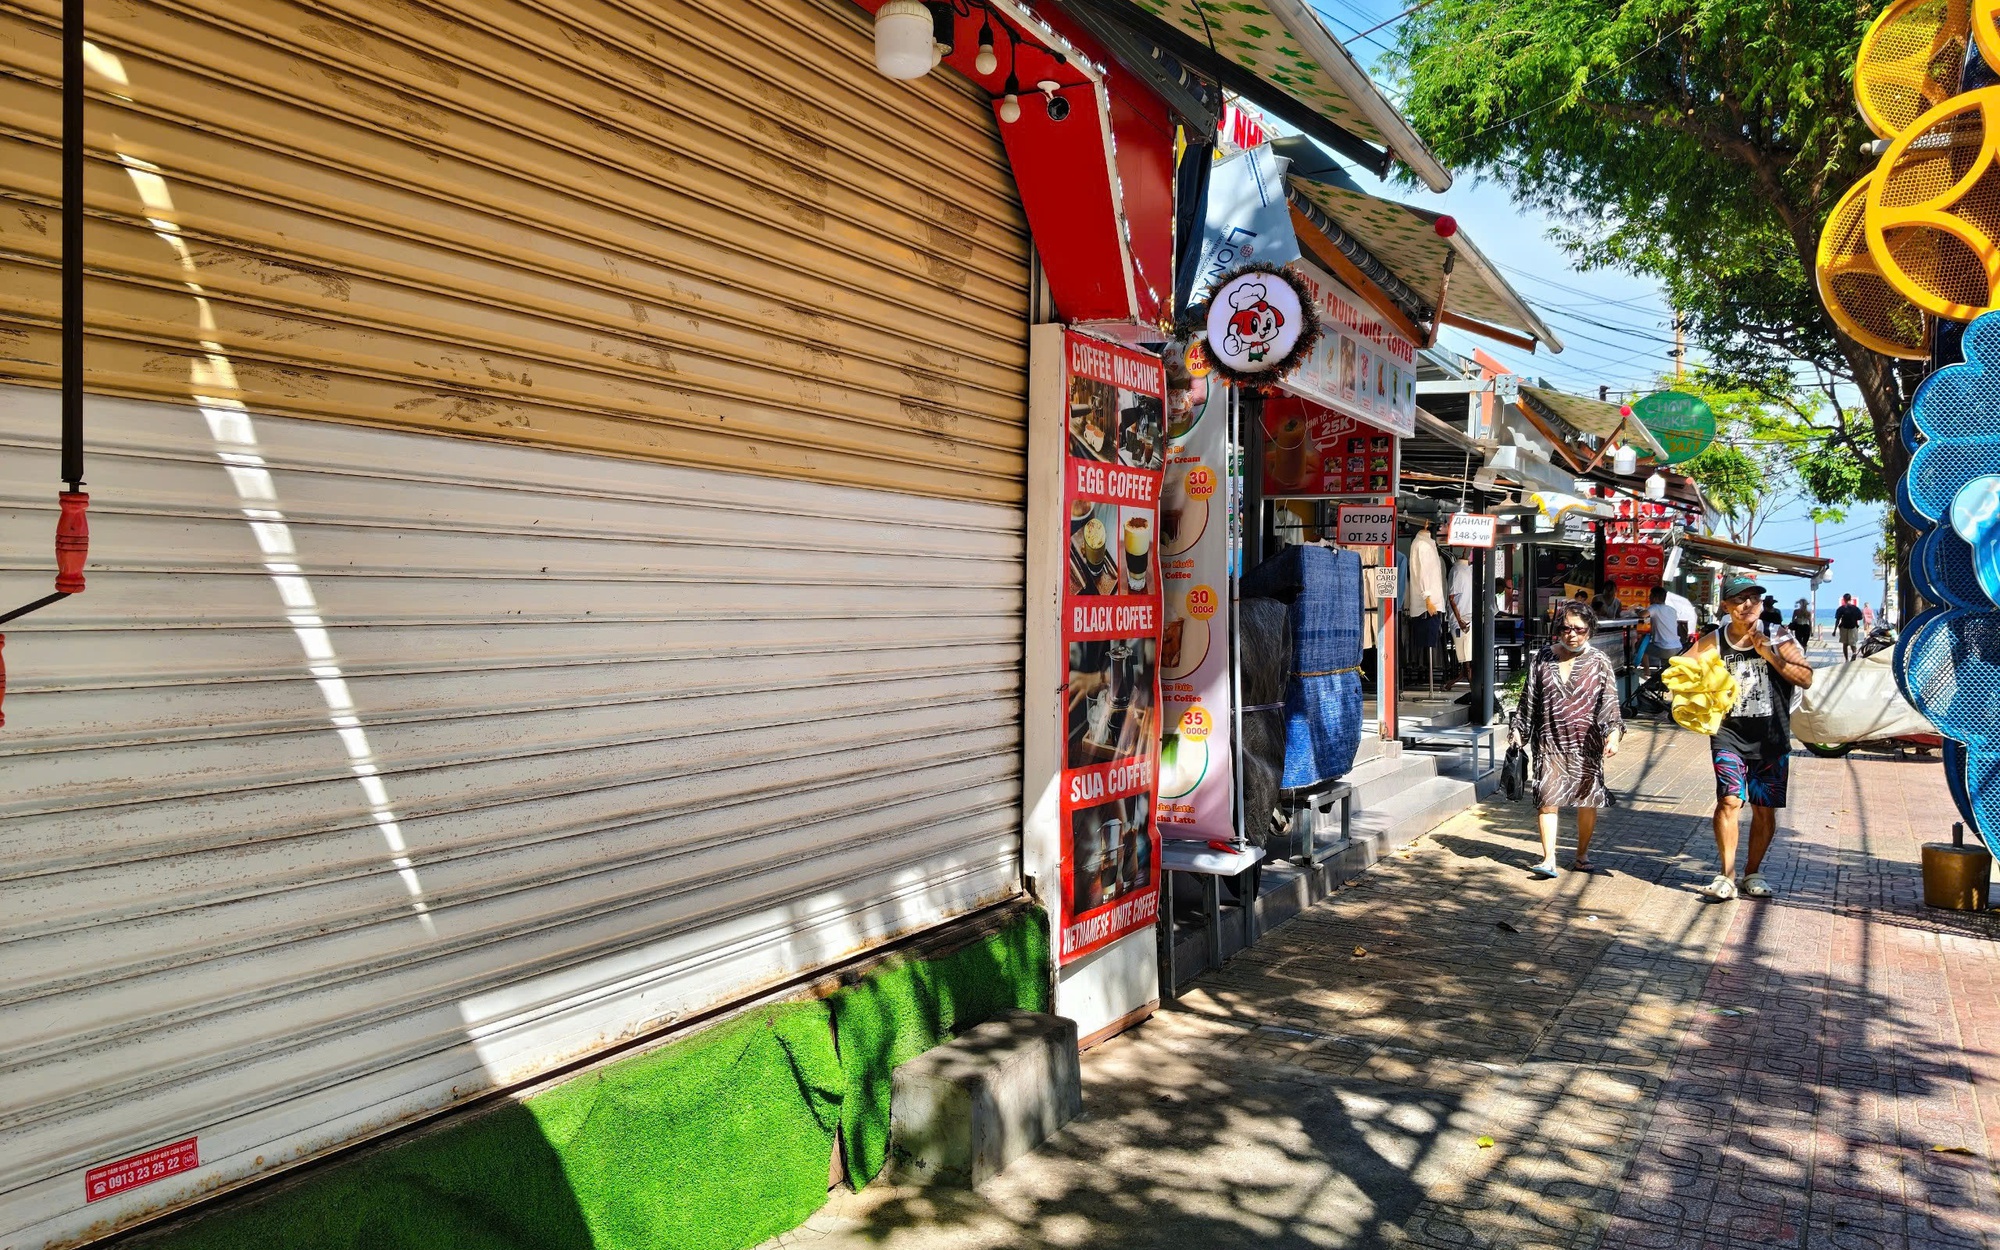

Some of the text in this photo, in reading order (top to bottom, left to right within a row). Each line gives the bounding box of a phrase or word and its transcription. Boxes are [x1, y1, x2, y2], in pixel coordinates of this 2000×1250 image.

[1187, 227, 1257, 308] LIONAL
[1326, 292, 1358, 331] FRUITS
[1359, 315, 1382, 345] JUICE
[1387, 332, 1413, 364] COFFEE
[1072, 341, 1160, 394] COFFEE MACHINE
[1321, 416, 1350, 436] 25K
[1174, 456, 1200, 464] Cream
[1077, 465, 1153, 501] EGG COFFEE
[1189, 471, 1208, 485] 30
[1343, 514, 1394, 524] ОСТРОВА
[1454, 517, 1492, 526] ДАНАНГ
[1348, 531, 1388, 543] ОТ 25 $
[1454, 531, 1470, 539] 148
[1165, 571, 1192, 579] Coffee
[1190, 590, 1209, 604] 30
[1073, 605, 1153, 633] BLACK COFFEE
[1174, 694, 1201, 703] Coffee
[1184, 712, 1203, 725] 35
[1070, 760, 1152, 803] SUA COFFEE
[1173, 803, 1195, 813] Latte
[1174, 815, 1196, 824] Latte
[1063, 891, 1157, 956] VIETNAMESE WHITE COFFEE
[109, 1156, 180, 1189] 0913 23 25 22
